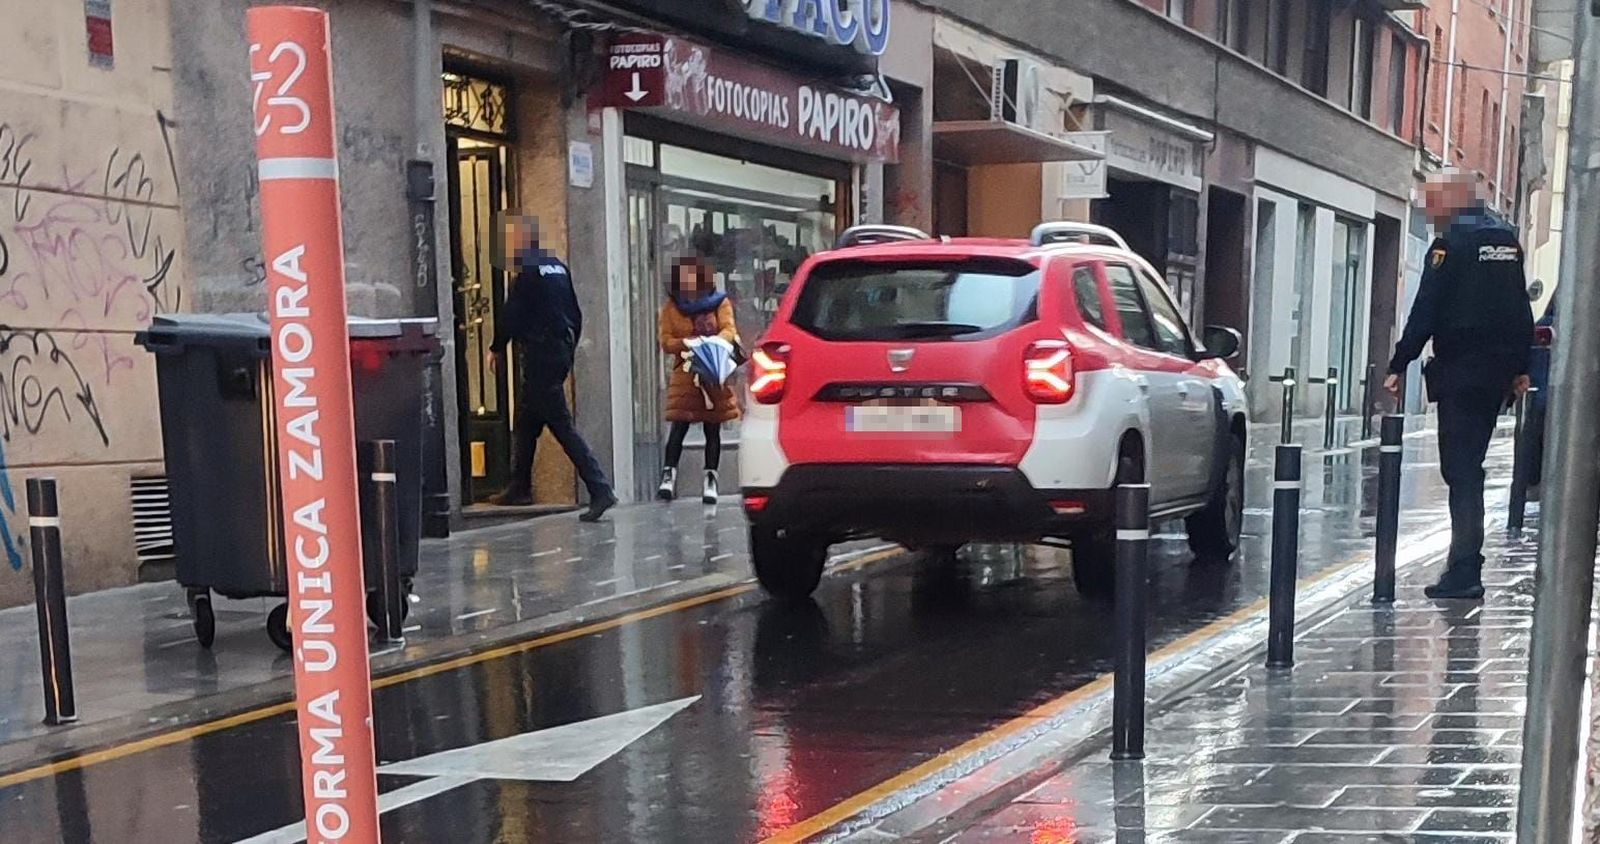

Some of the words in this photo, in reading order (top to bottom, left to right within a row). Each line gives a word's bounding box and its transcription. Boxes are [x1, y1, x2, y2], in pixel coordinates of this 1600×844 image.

[610, 54, 661, 70] PAPIRO
[707, 75, 790, 129] FOTOCOPIAS
[798, 85, 876, 150] PAPIRO
[272, 244, 324, 481] ZAMORA
[292, 497, 337, 673] ÚNICA
[309, 689, 350, 844] ORMA
